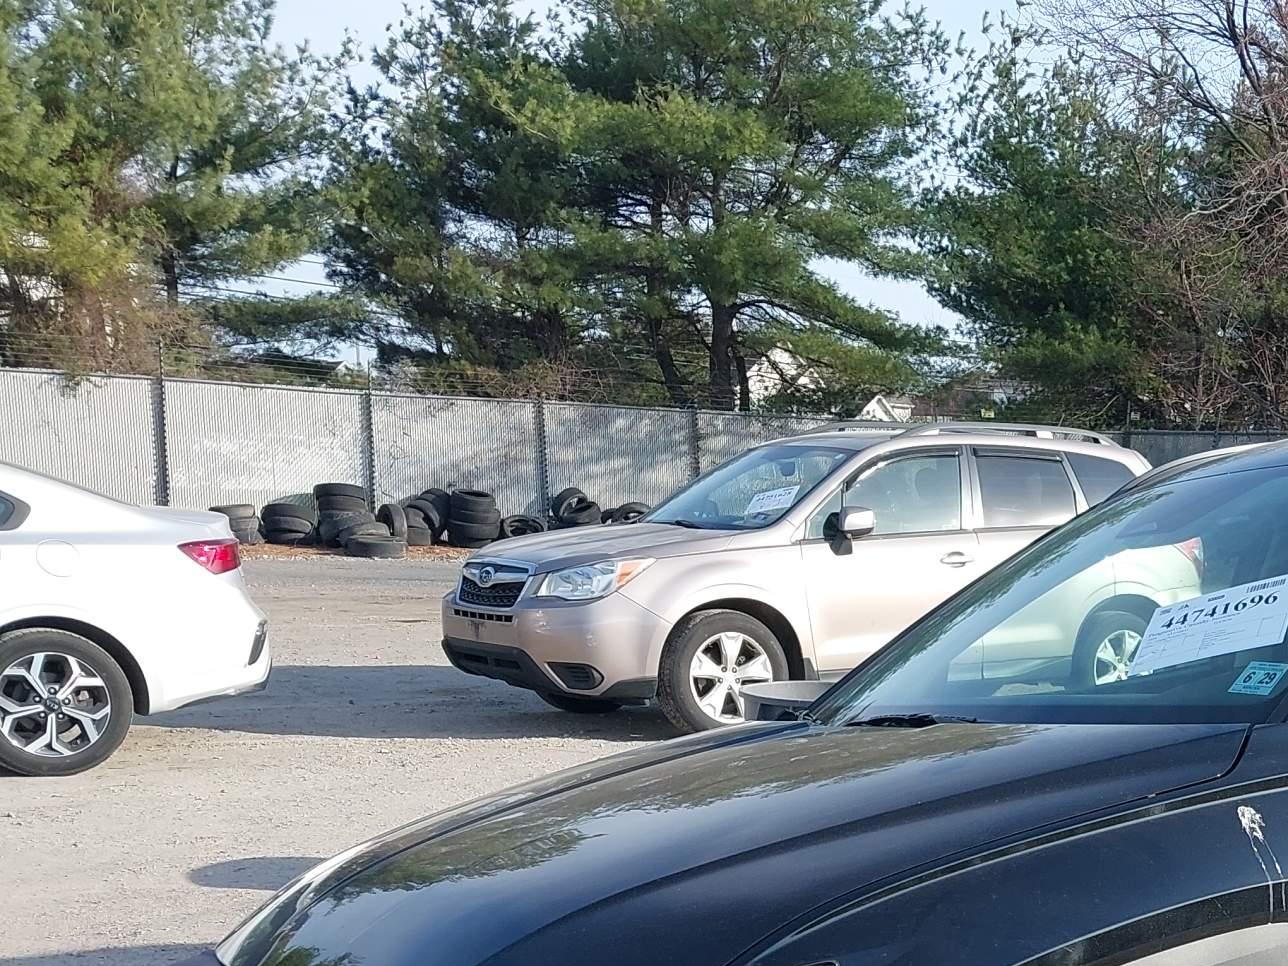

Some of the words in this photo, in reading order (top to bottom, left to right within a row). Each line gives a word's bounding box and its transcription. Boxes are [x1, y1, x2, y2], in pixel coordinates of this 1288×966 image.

[1160, 590, 1281, 630] 44741696
[1242, 671, 1256, 684] 6
[1257, 671, 1278, 685] 29
